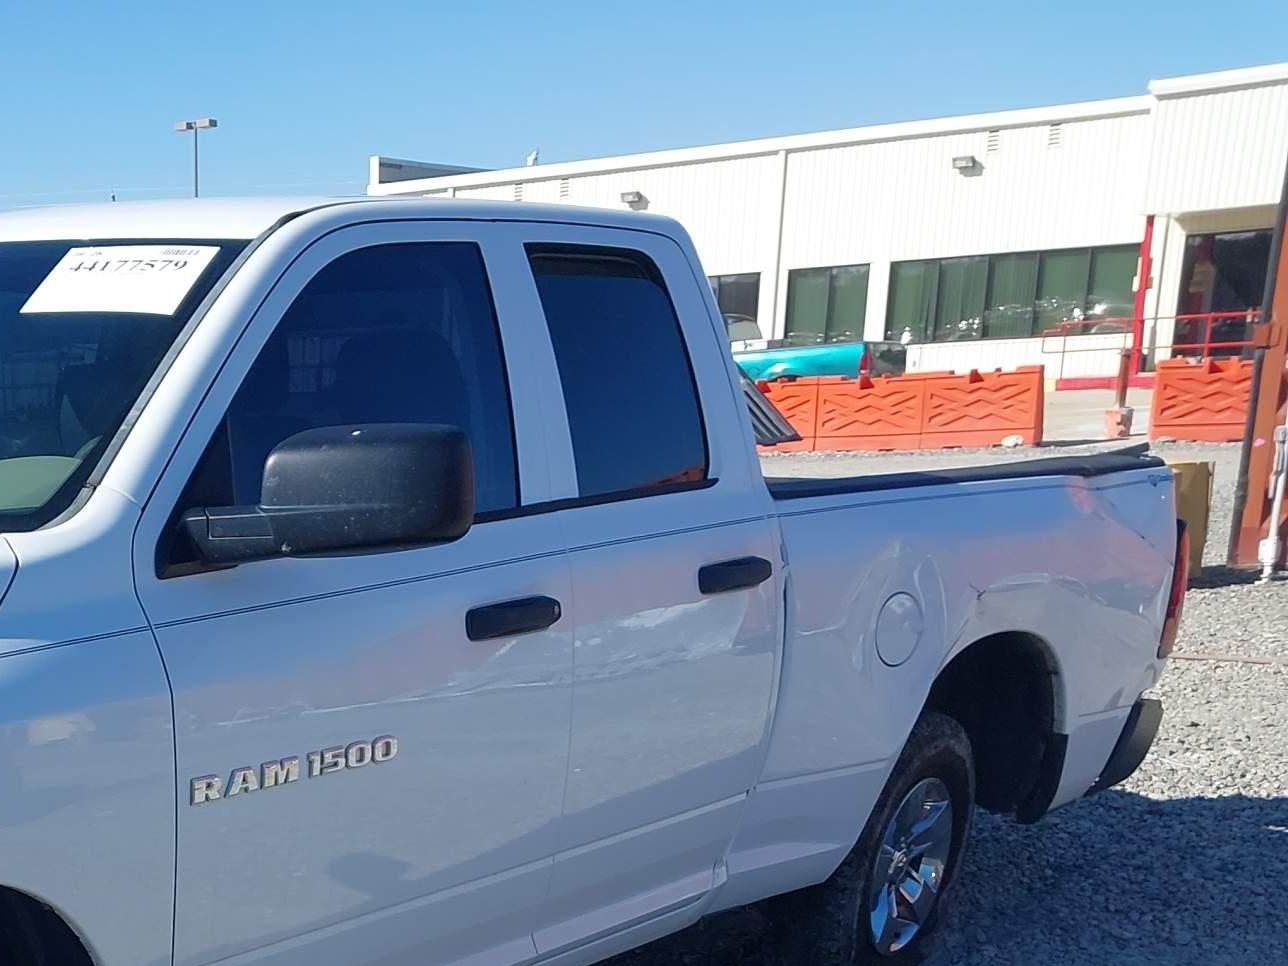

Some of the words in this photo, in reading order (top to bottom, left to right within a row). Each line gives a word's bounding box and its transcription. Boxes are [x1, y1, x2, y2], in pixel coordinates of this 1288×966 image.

[68, 259, 189, 272] 44177579
[190, 755, 300, 806] RAM
[307, 734, 399, 779] 1500
